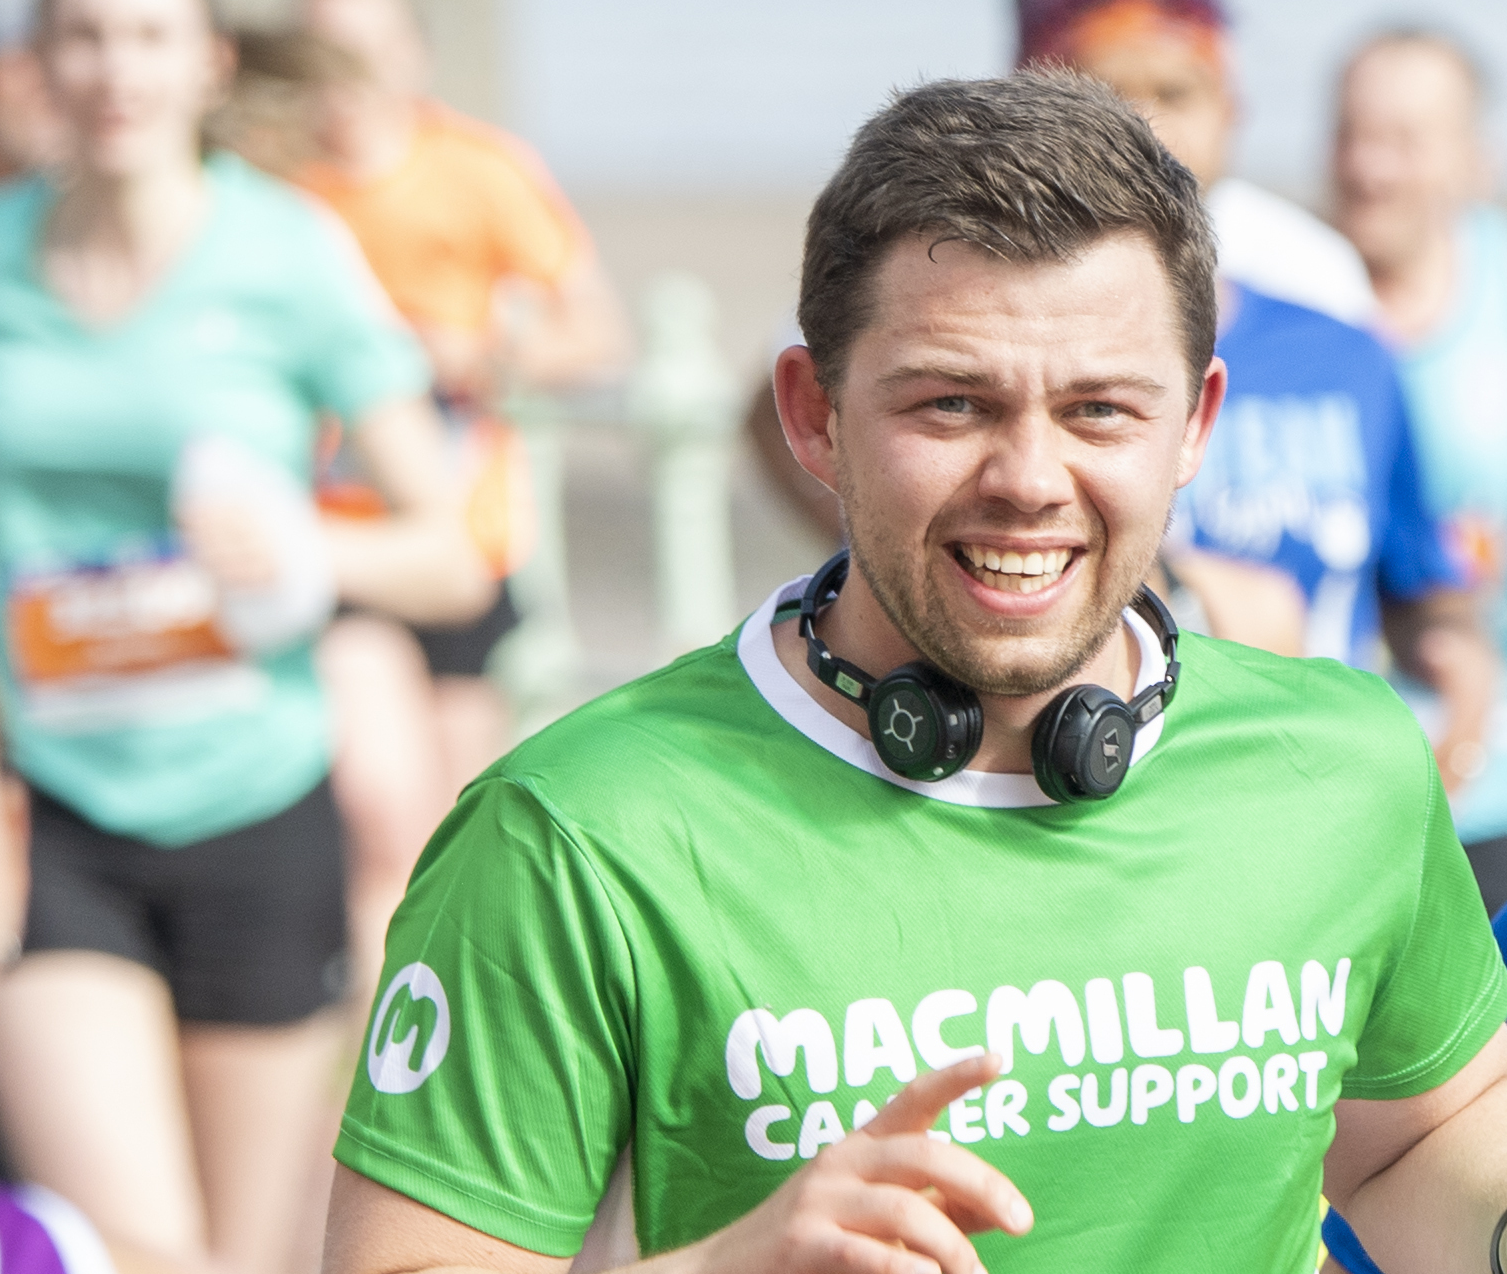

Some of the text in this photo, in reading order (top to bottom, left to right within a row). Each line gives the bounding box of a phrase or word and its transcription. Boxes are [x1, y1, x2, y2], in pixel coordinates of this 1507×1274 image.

[725, 957, 1351, 1100] MACMILLAN
[745, 1050, 1328, 1161] CAER SUPPORT
